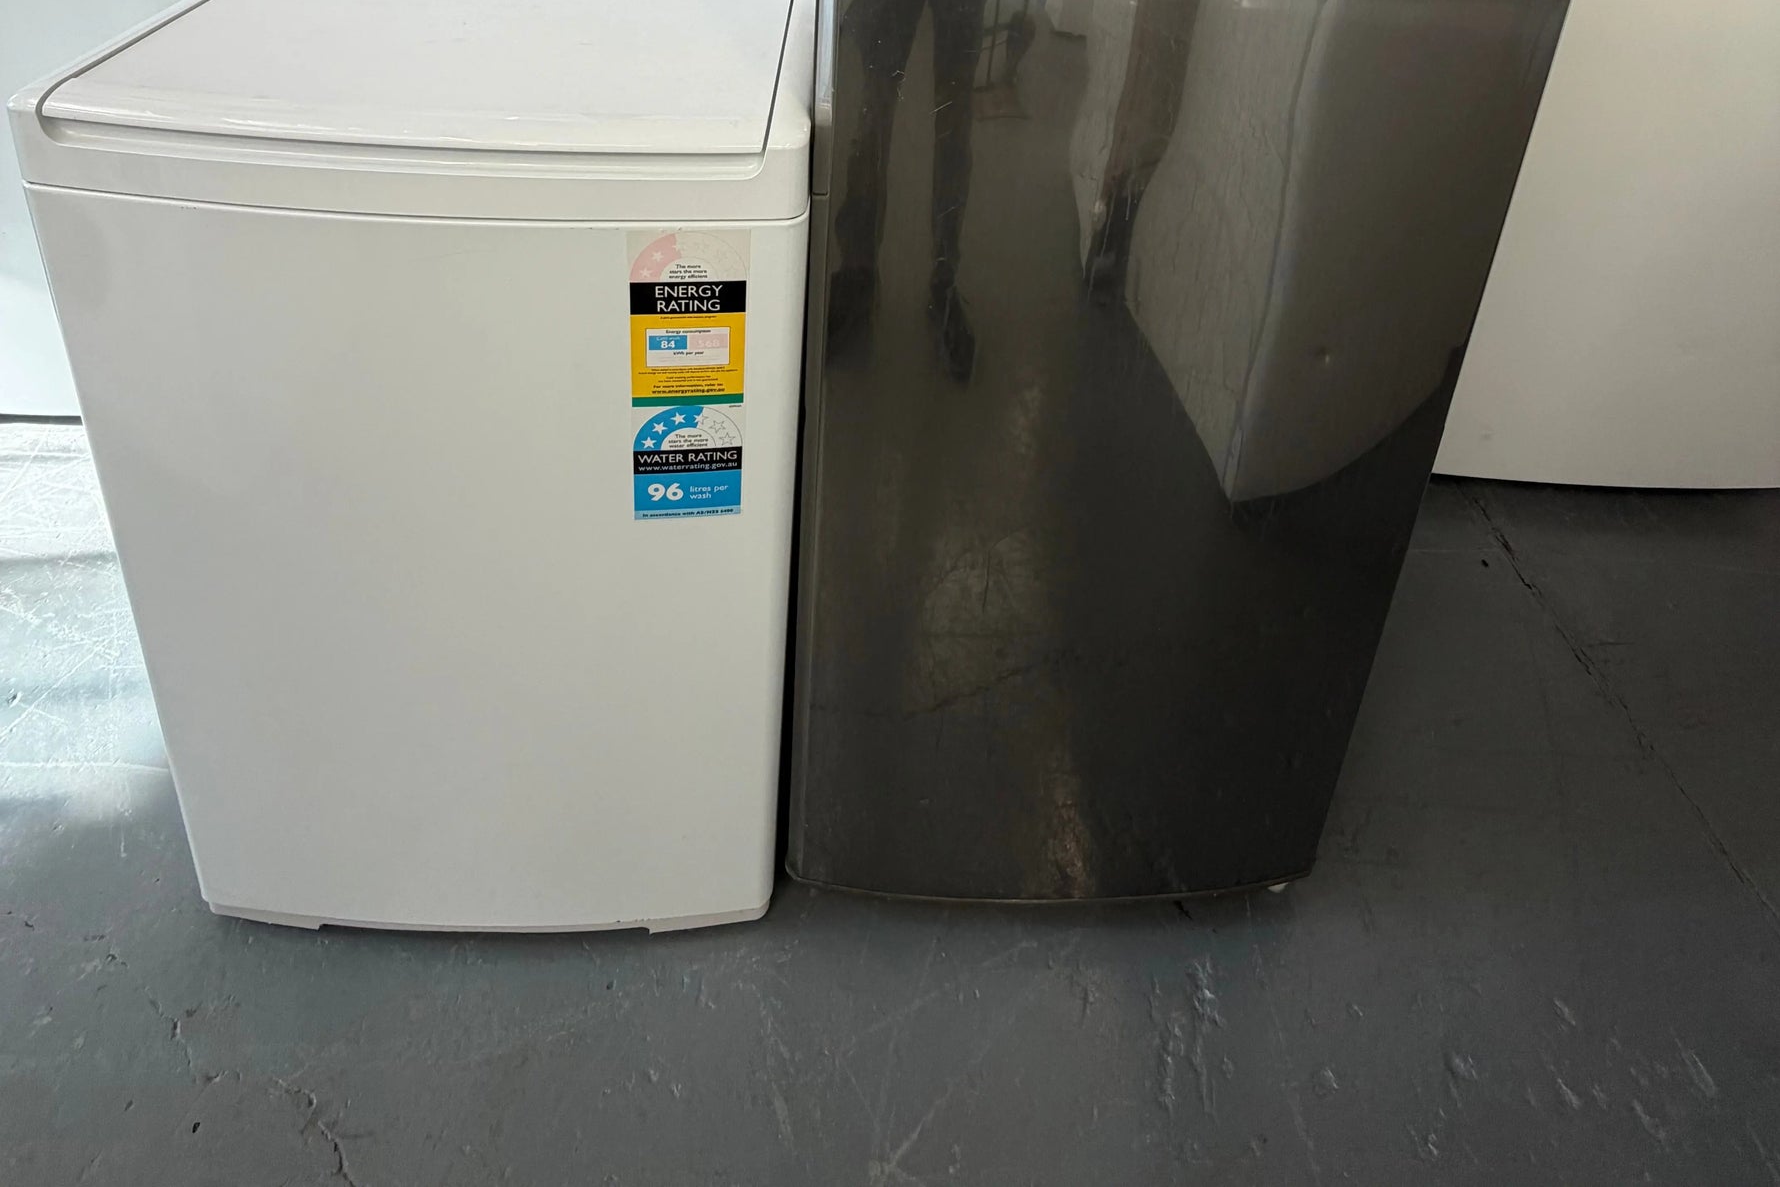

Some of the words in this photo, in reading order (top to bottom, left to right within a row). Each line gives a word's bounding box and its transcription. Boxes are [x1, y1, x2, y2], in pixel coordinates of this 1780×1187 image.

[655, 285, 723, 298] ENERGY
[656, 299, 721, 312] RATING
[660, 340, 676, 349] 84
[637, 453, 684, 464] WATER
[688, 450, 738, 462] RATING
[638, 461, 738, 471] www.waterrating.gov.au
[647, 482, 684, 501] 96
[714, 484, 729, 492] per
